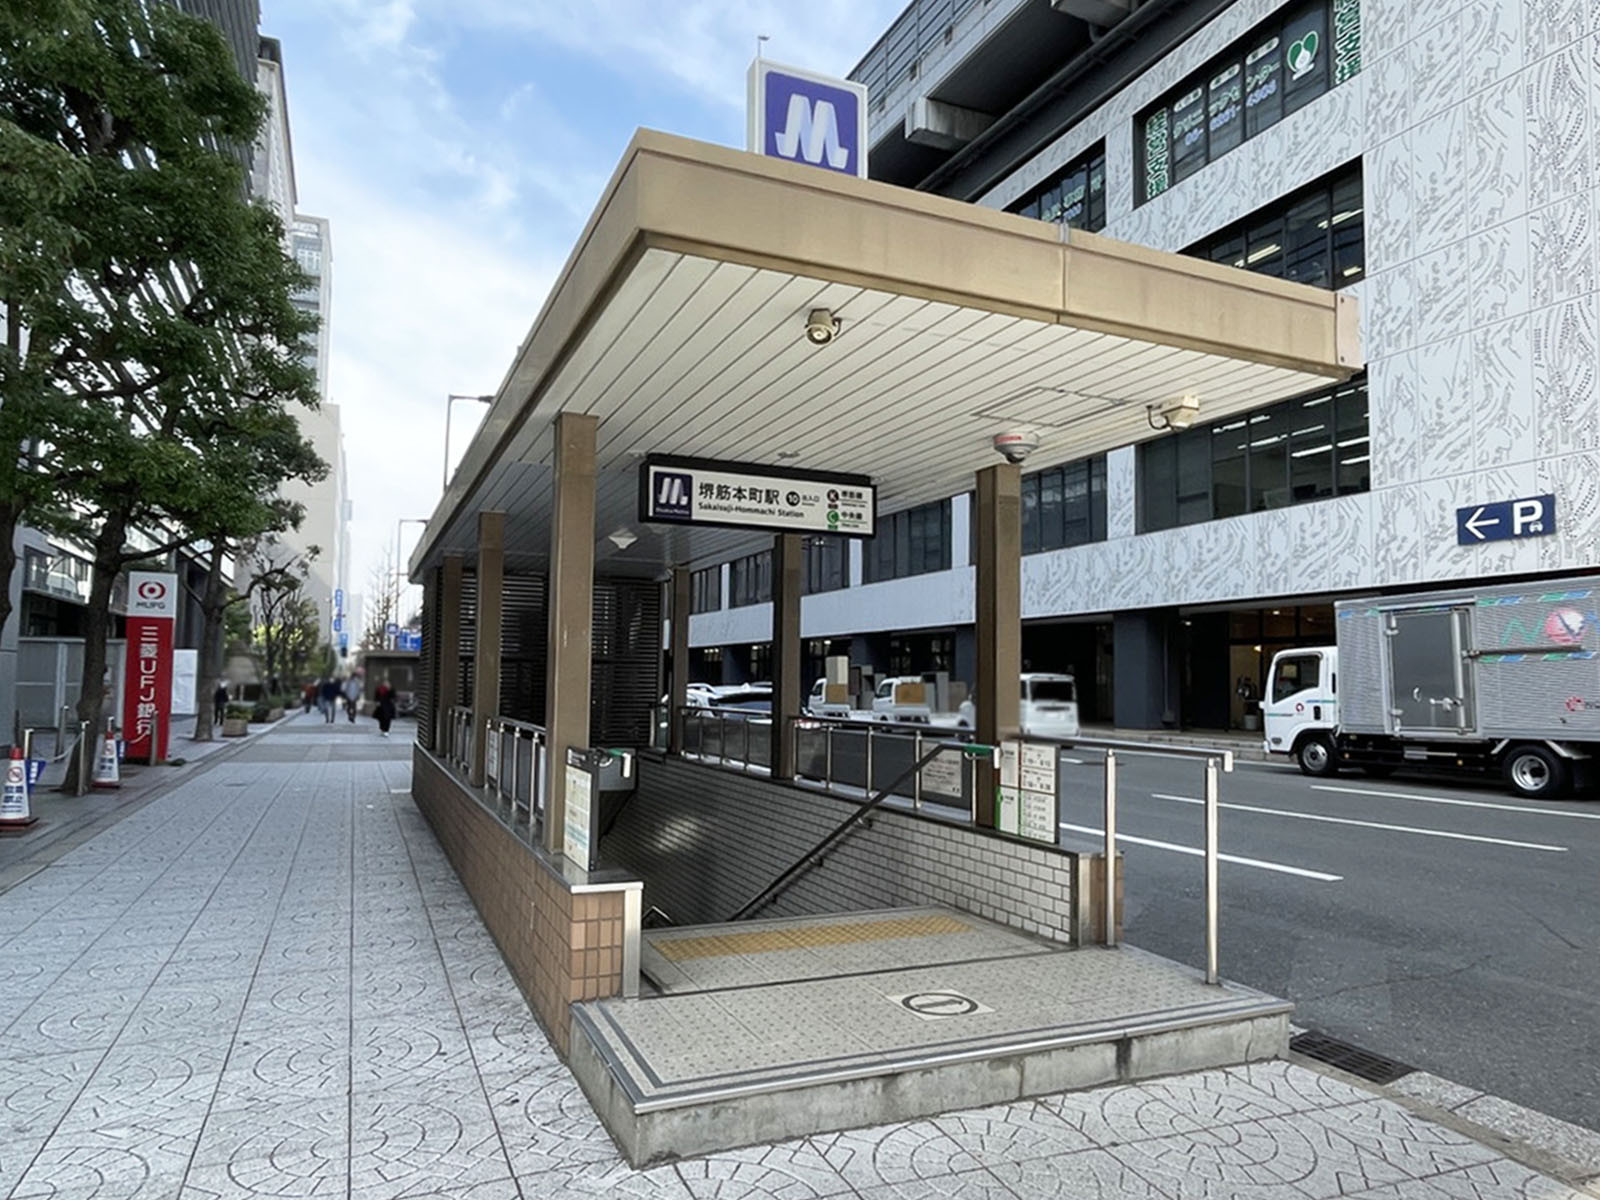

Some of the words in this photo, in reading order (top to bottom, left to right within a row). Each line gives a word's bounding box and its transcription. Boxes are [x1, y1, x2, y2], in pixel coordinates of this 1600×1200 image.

[698, 482, 781, 505] 堺筋本町駅
[777, 508, 804, 519] Station
[1513, 500, 1543, 535] P
